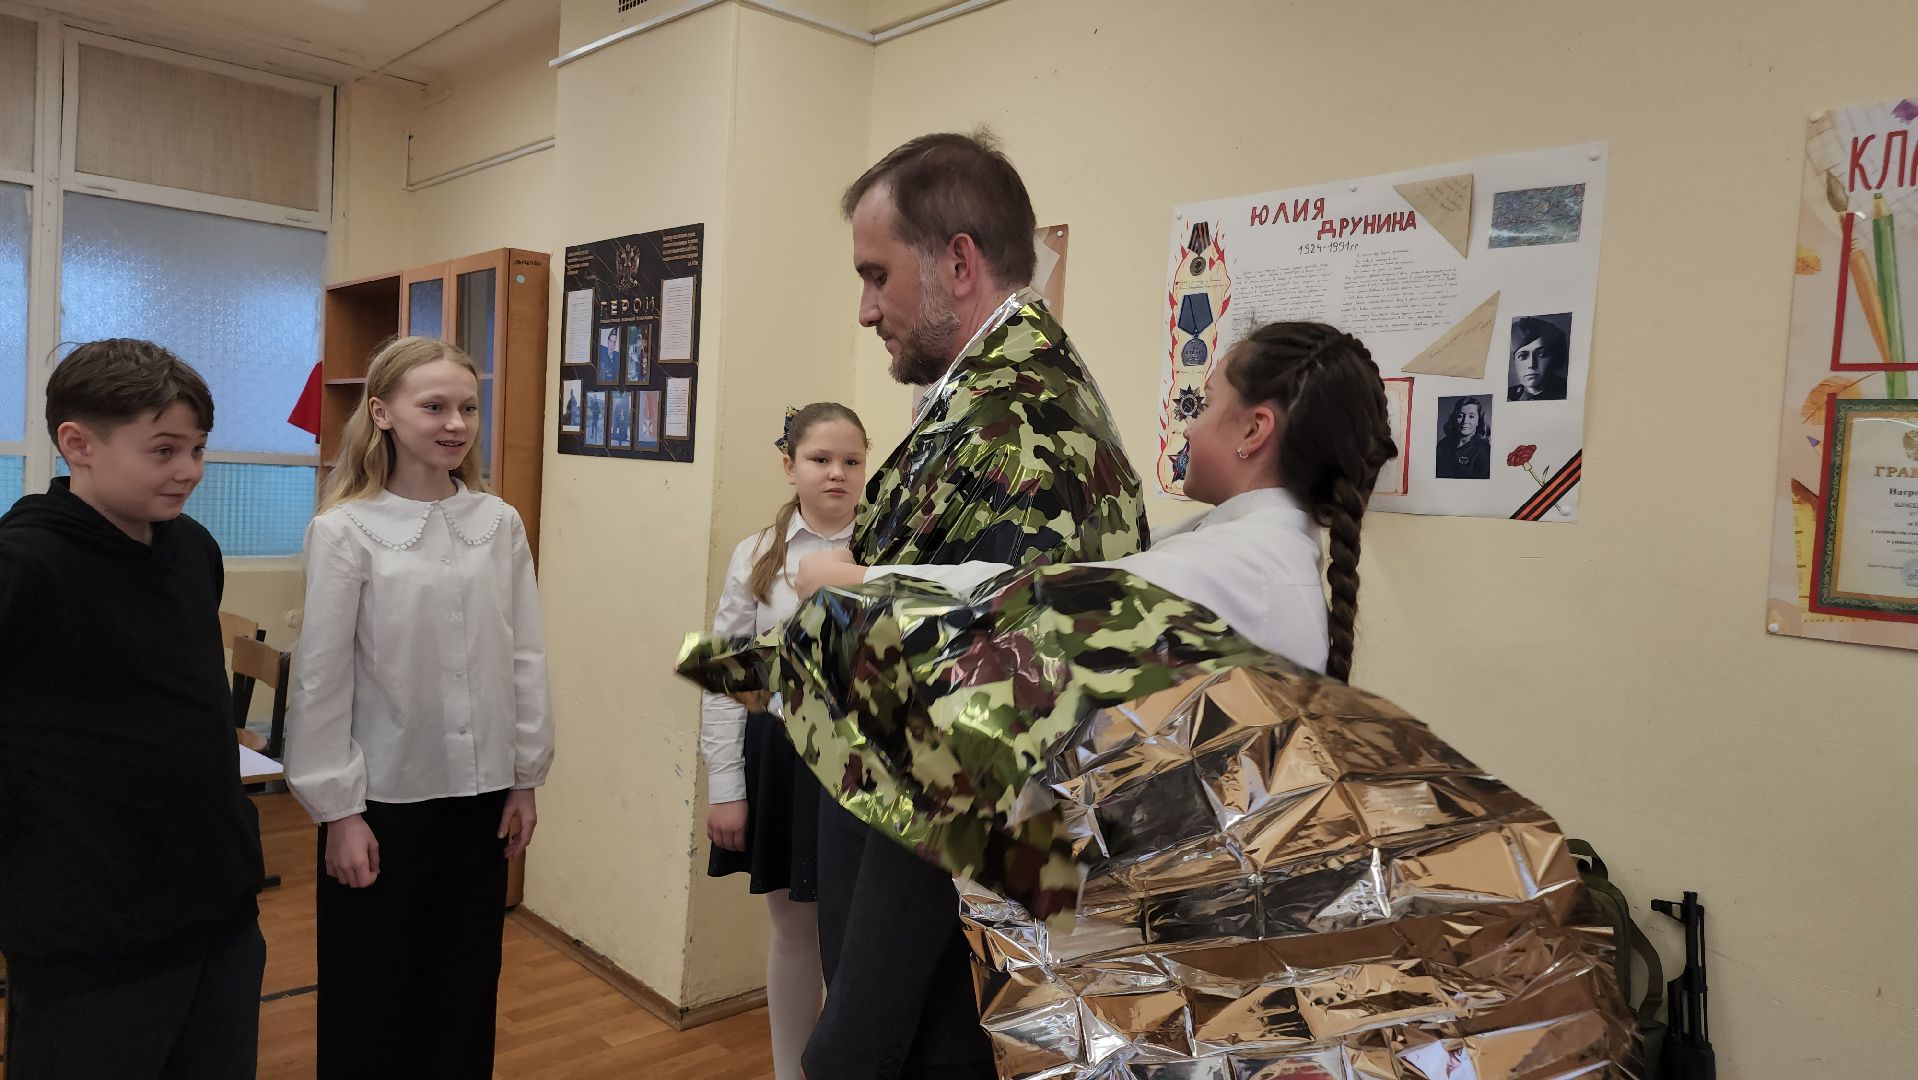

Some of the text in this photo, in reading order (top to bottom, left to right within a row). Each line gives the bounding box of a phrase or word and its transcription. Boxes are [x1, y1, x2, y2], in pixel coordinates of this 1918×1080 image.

[1250, 197, 1325, 226] ЮЛИЯ
[1316, 210, 1417, 240] ДРУНИНА
[600, 296, 655, 316] ГЕРОИ
